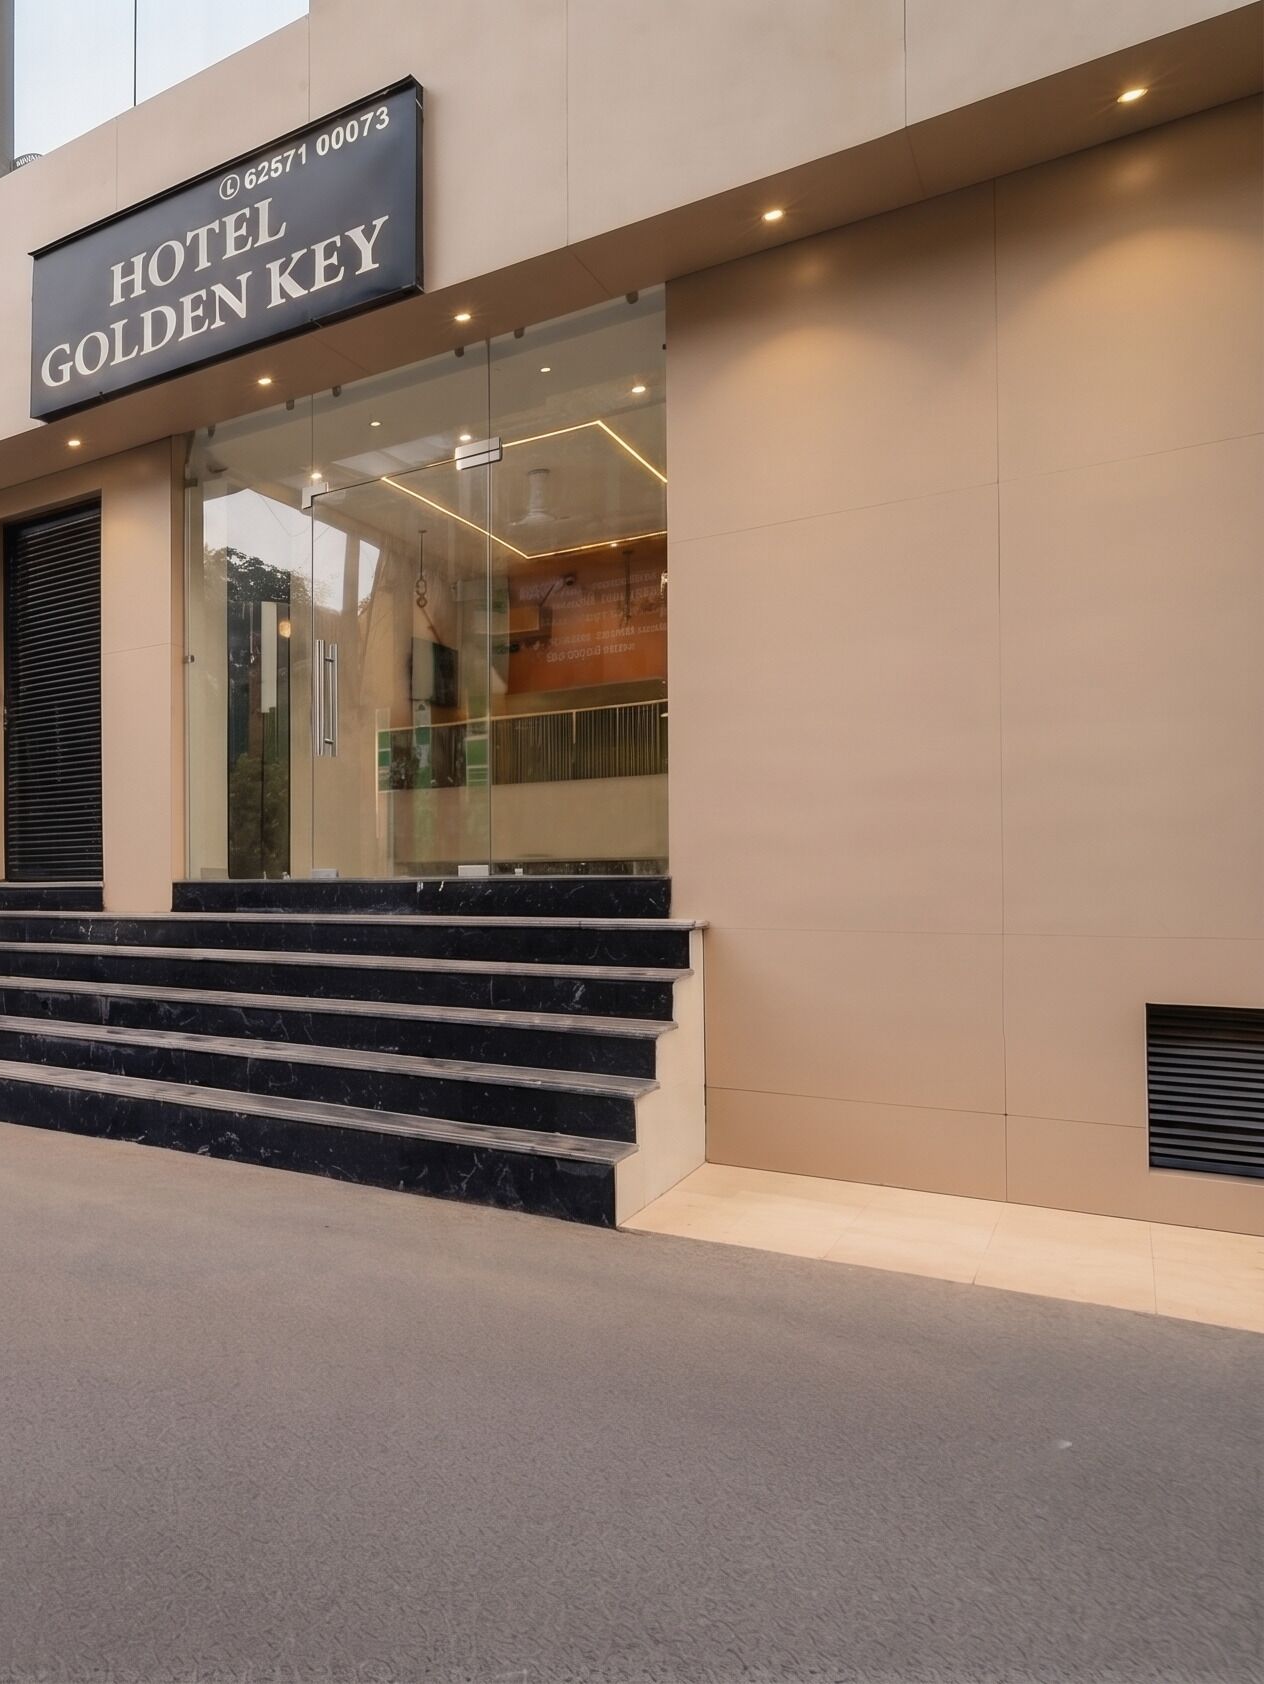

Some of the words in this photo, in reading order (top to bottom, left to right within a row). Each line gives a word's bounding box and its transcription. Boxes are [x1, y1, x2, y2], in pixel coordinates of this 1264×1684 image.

[244, 143, 307, 190] 62571
[316, 106, 390, 156] 00073
[41, 270, 253, 387] GOLDEN
[266, 215, 389, 309] KEY
[109, 197, 287, 307] HOTEL
